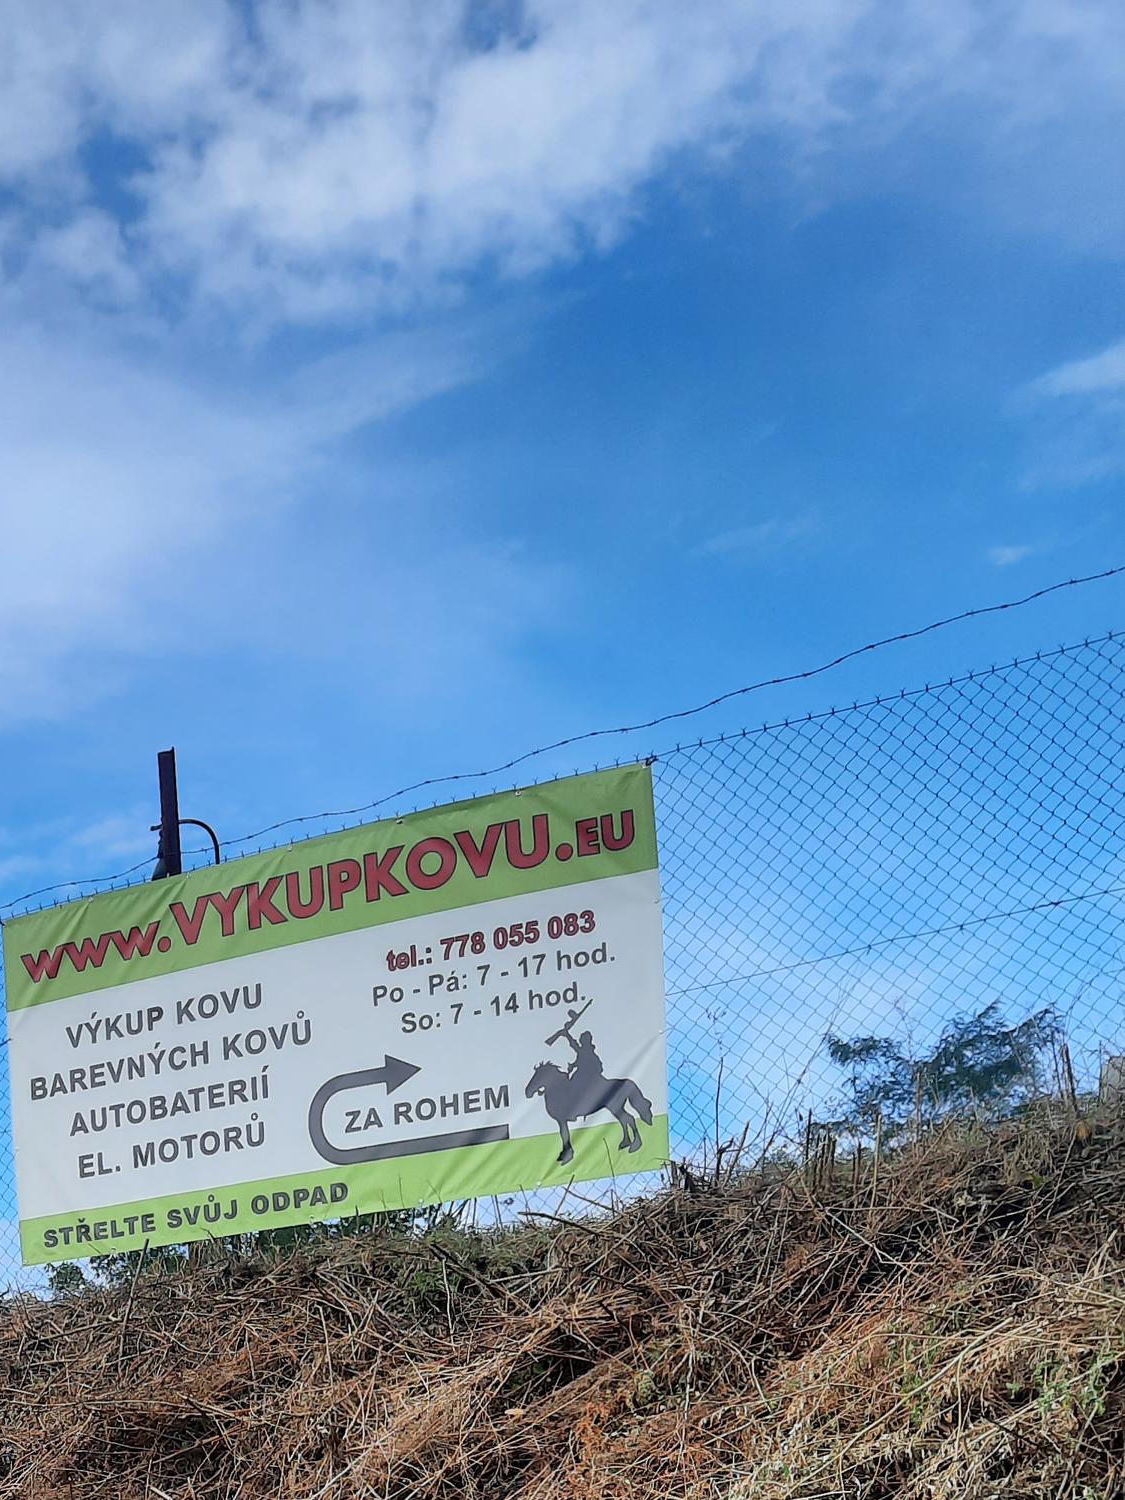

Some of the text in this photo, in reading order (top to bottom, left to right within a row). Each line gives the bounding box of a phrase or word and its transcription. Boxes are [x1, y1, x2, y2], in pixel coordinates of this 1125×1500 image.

[386, 910, 595, 971] tel.: 778 055 083
[372, 983, 404, 1007] Po
[428, 970, 468, 995] Pá:
[517, 954, 546, 978] 17
[556, 942, 615, 971] hod.
[66, 983, 263, 1049] VÝKUP KOVU
[401, 1010, 442, 1034] So:
[491, 994, 519, 1017] 14
[527, 982, 585, 1010] hod.
[30, 1010, 311, 1100] BAREVNÝCH KOVŮ
[70, 1066, 269, 1136] AUTOBATERIÍ
[344, 1084, 510, 1134] ZA ROHEM
[78, 1113, 265, 1178] EL. MOTORŮ
[43, 1182, 348, 1248] STŘELTE SVŮJ ODPAD
